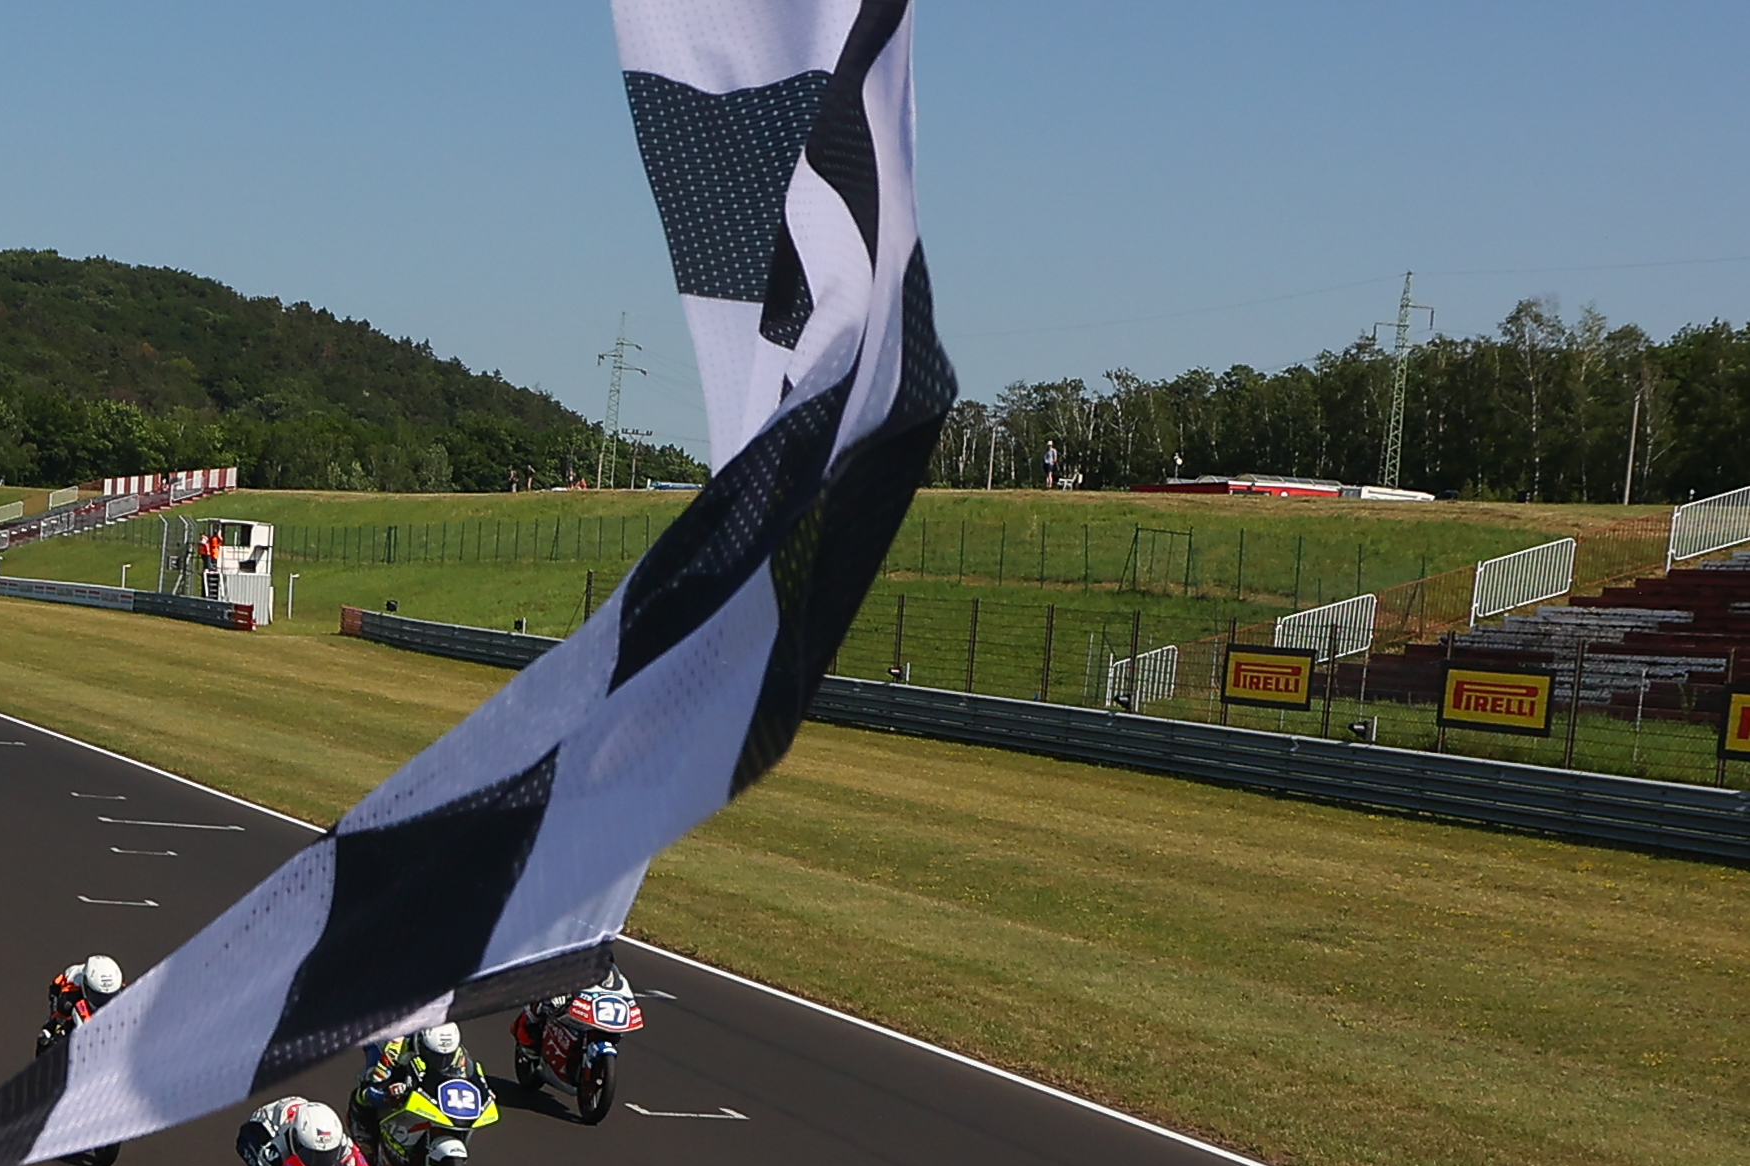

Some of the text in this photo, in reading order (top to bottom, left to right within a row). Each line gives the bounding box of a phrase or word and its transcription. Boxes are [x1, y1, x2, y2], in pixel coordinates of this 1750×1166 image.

[1233, 661, 1302, 693] PIRELLI
[1452, 680, 1539, 717] PIRELLI
[598, 1001, 626, 1023] 27
[447, 1089, 475, 1110] 12
